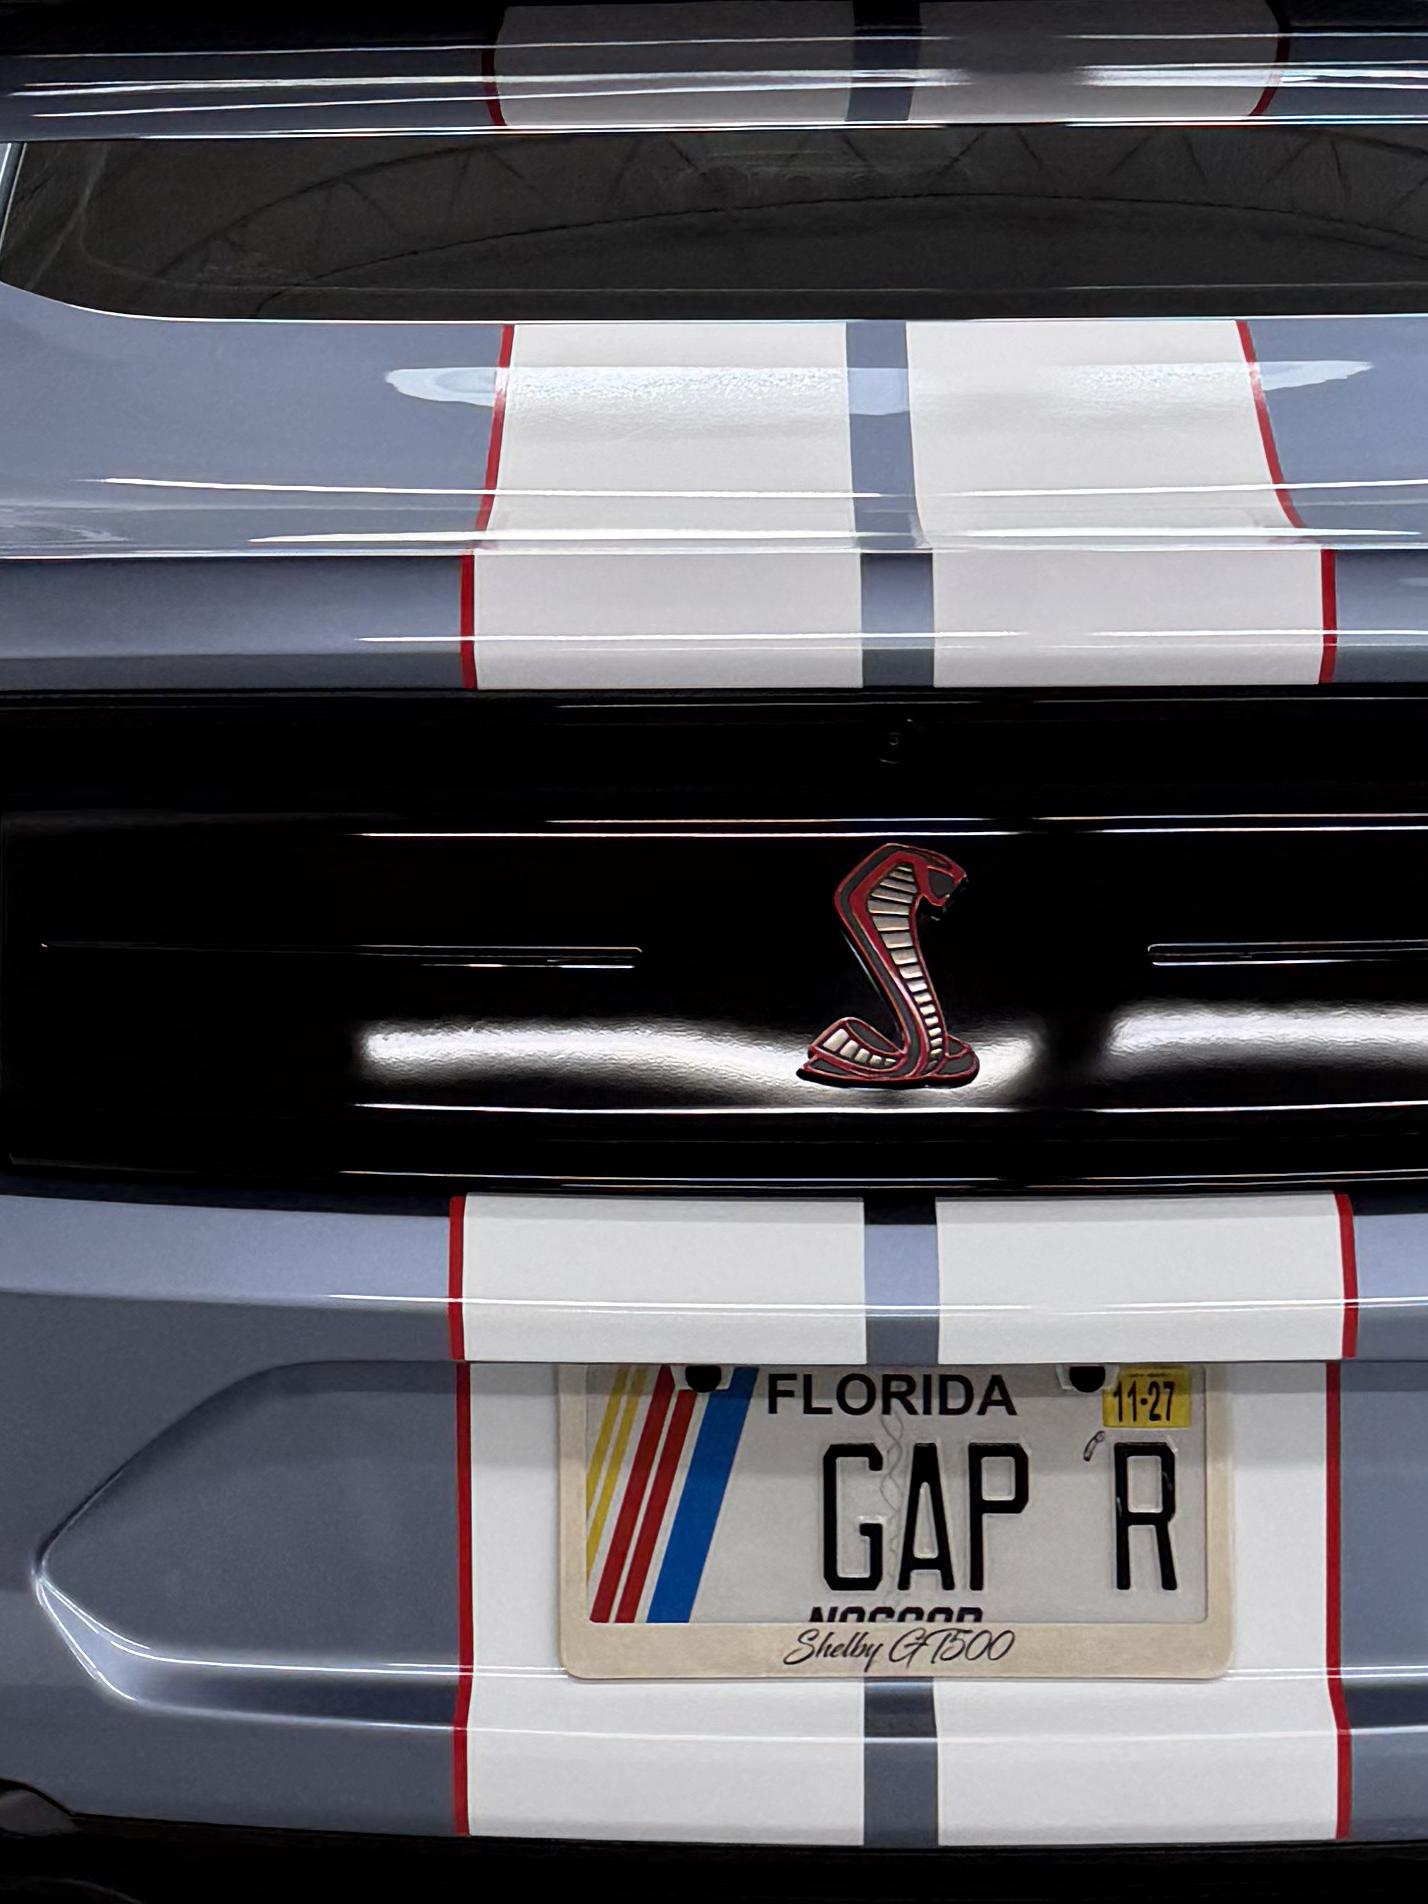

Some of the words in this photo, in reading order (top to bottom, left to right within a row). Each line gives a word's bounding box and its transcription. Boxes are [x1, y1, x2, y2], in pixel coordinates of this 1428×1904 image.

[767, 1372, 1018, 1417] FLORIDA
[822, 1442, 1030, 1592] GAP
[1113, 1441, 1178, 1591] R
[782, 1627, 884, 1673] Shelby
[888, 1627, 1016, 1669] GT500
